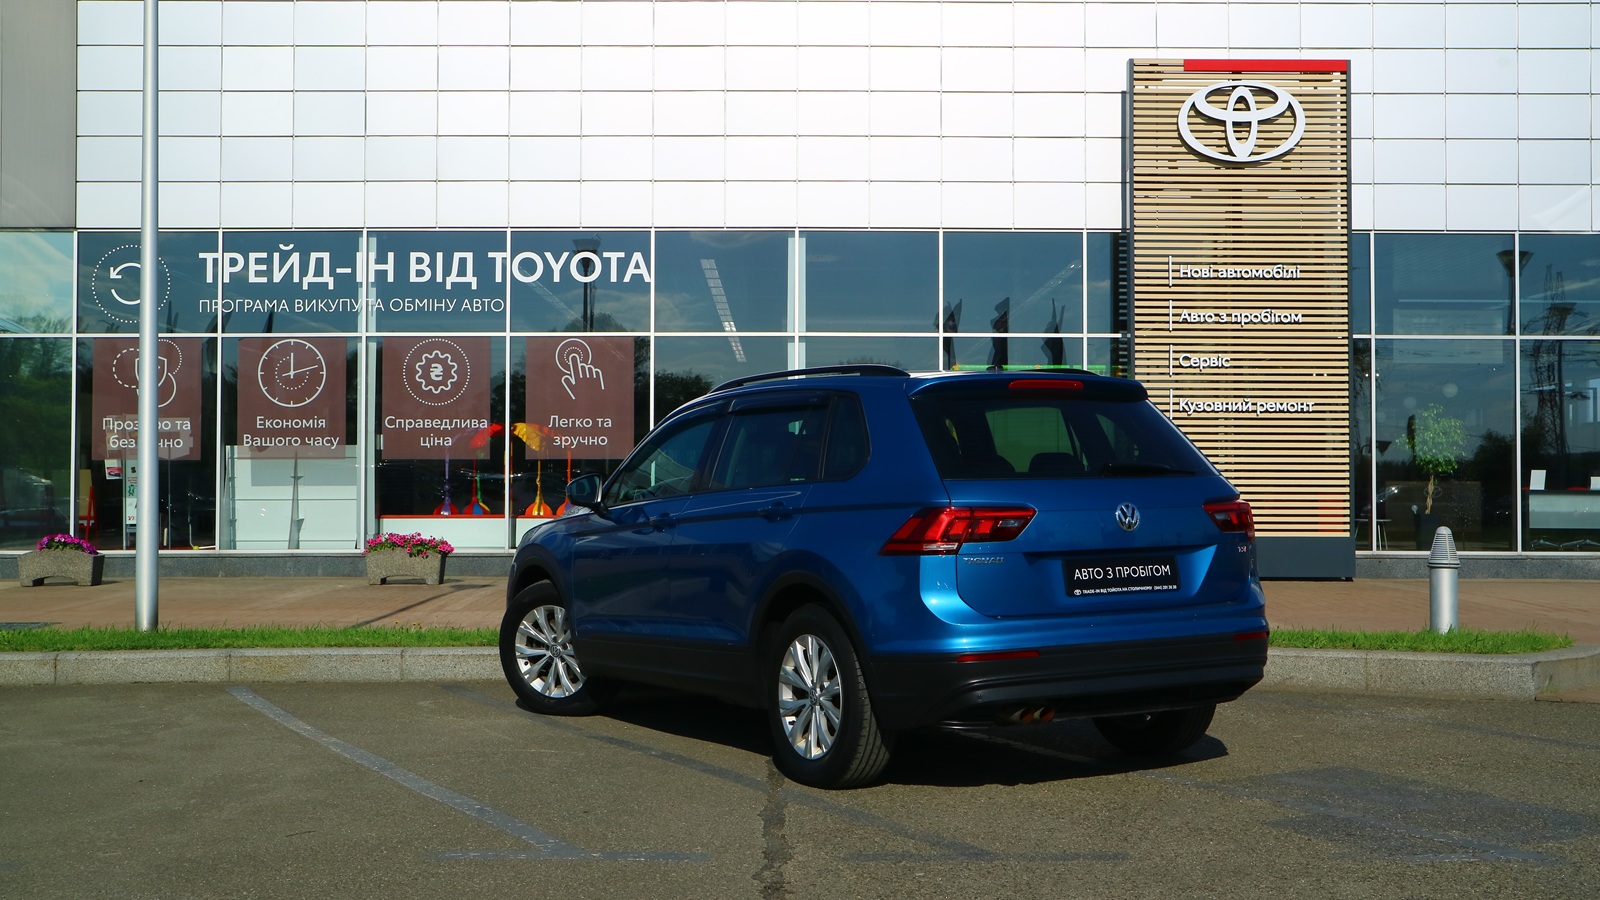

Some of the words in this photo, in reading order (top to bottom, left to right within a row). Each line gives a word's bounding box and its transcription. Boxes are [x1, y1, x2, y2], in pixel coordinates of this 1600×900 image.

[199, 243, 395, 290] ТРЕЙД-ІН
[409, 252, 477, 290] ВІД
[488, 251, 652, 283] TOYOTA
[1180, 265, 1213, 278] Нові
[1217, 265, 1300, 278] автомобілі
[199, 299, 289, 313] ПРОГРАМА
[294, 299, 361, 313] ВИКУПУ
[389, 298, 457, 312] ОБМІНУ
[461, 298, 505, 312] АВТО
[1179, 309, 1215, 323] Авто
[1219, 313, 1227, 323] з
[1231, 309, 1302, 326] пробігом
[1179, 353, 1231, 370] Сервіс
[1179, 398, 1252, 414] Кузовний
[1256, 401, 1315, 414] ремонт
[102, 417, 171, 433] Прозо
[175, 420, 191, 431] та
[256, 416, 326, 429] Економія
[384, 416, 488, 431] Справедлива
[548, 416, 592, 428] Легко
[596, 418, 612, 428] та
[243, 434, 301, 447] Вашого
[305, 436, 340, 450] часу
[420, 434, 452, 447] ціна
[553, 436, 608, 449] зручно
[1074, 568, 1104, 580] АВТО
[1106, 567, 1114, 579] З
[1116, 565, 1171, 578] ПРОБІГОМ
